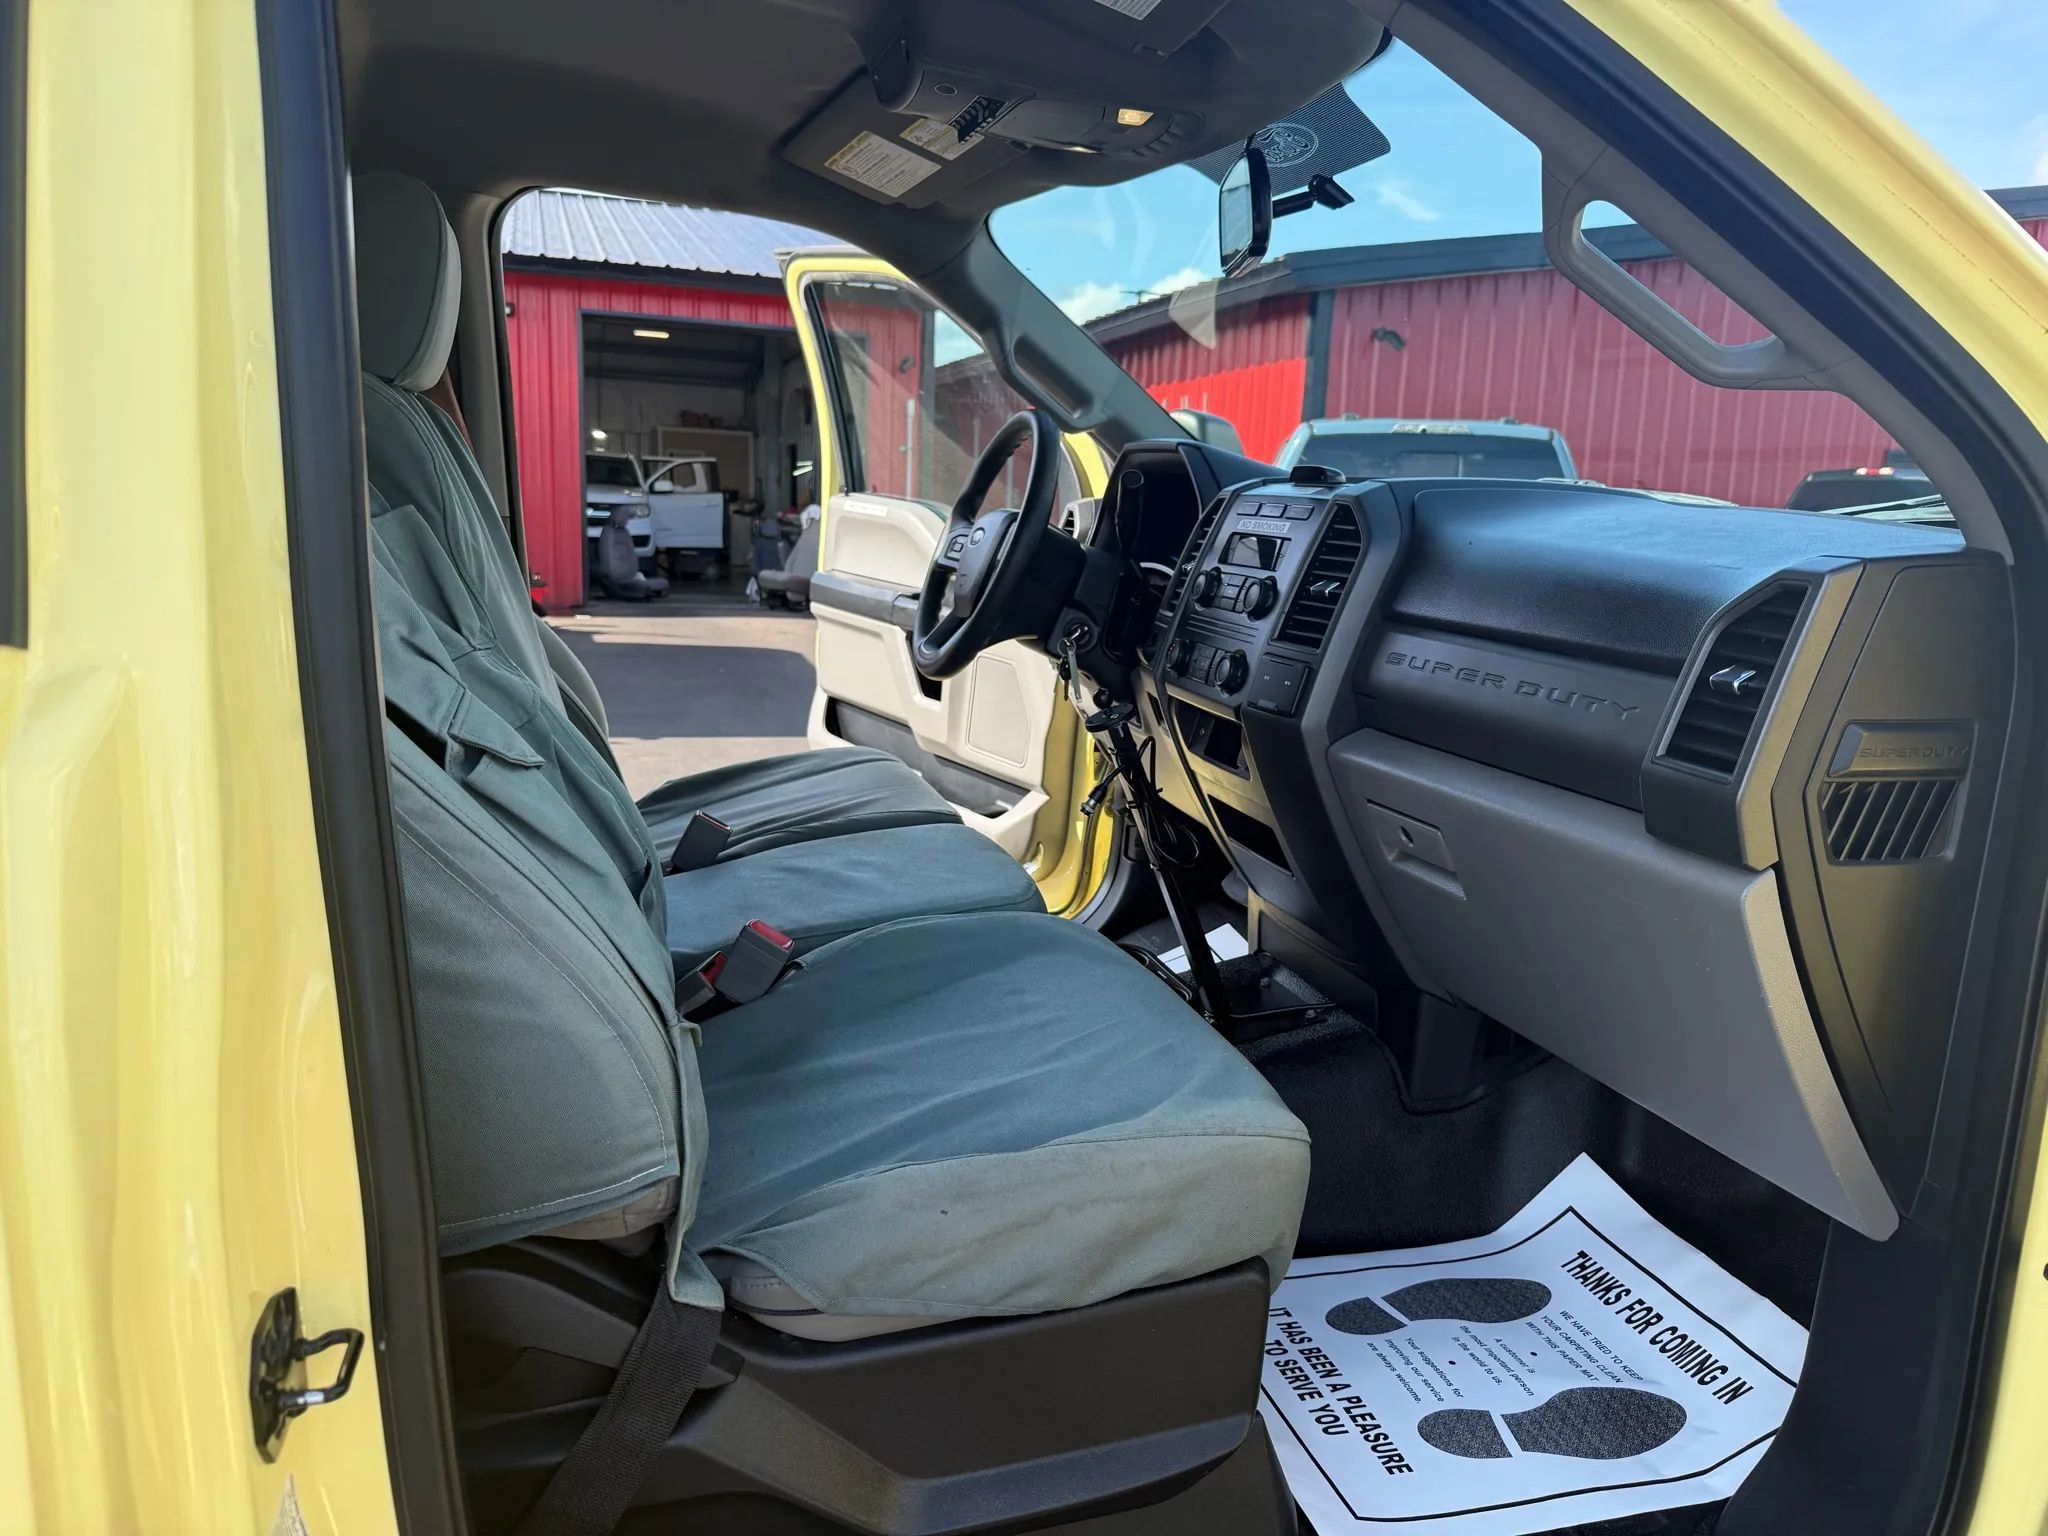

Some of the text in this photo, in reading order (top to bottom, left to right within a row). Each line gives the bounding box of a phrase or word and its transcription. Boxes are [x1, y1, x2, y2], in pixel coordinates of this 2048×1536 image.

[1384, 651, 1640, 721] SUPER DUTY
[1457, 1342, 1470, 1352] the
[1468, 1352, 1489, 1369] world
[1484, 1367, 1494, 1376] to
[1459, 1325, 1535, 1397] the most important person
[1499, 1343, 1529, 1369] customer
[1527, 1367, 1536, 1375] is
[1525, 1321, 1600, 1383] WITH THIS PAPER MAT
[1540, 1315, 1624, 1384] YOUR CARPETING CLEAN
[1559, 1310, 1644, 1382] WE HAVE TRIED TO KEEP
[1560, 1249, 1754, 1405] THANKS FOR COMING IN
[1264, 1339, 1350, 1436] TO SERVE YOU
[1268, 1306, 1414, 1476] IT HAS BEEN A PLEASURE
[1366, 1341, 1422, 1404] are always welcome.
[1404, 1337, 1464, 1399] Your suggestions for
[1411, 1366, 1425, 1378] our
[1421, 1378, 1445, 1403] service
